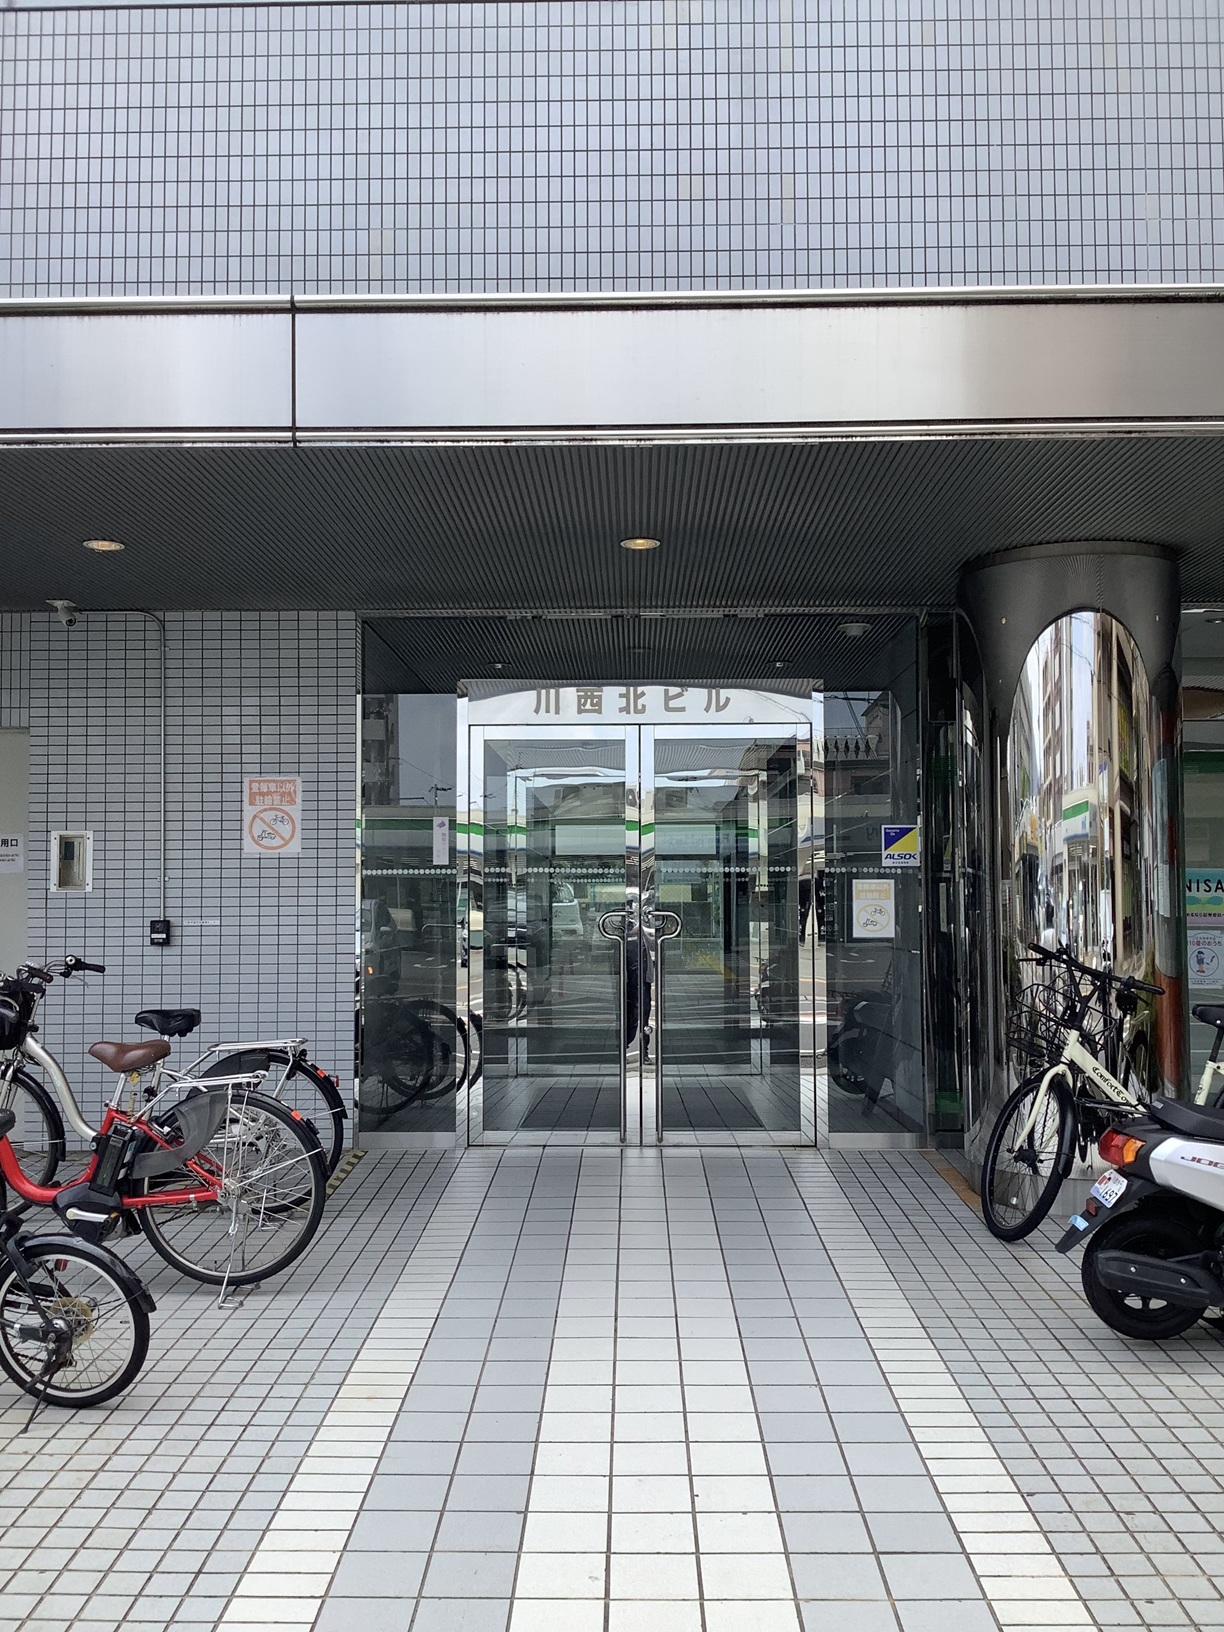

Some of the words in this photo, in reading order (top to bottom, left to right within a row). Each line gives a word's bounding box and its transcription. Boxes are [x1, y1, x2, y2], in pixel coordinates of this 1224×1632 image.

[533, 687, 731, 715] 川西北ビル
[1185, 879, 1224, 892] NISA
[1099, 1186, 1119, 1203] 1697
